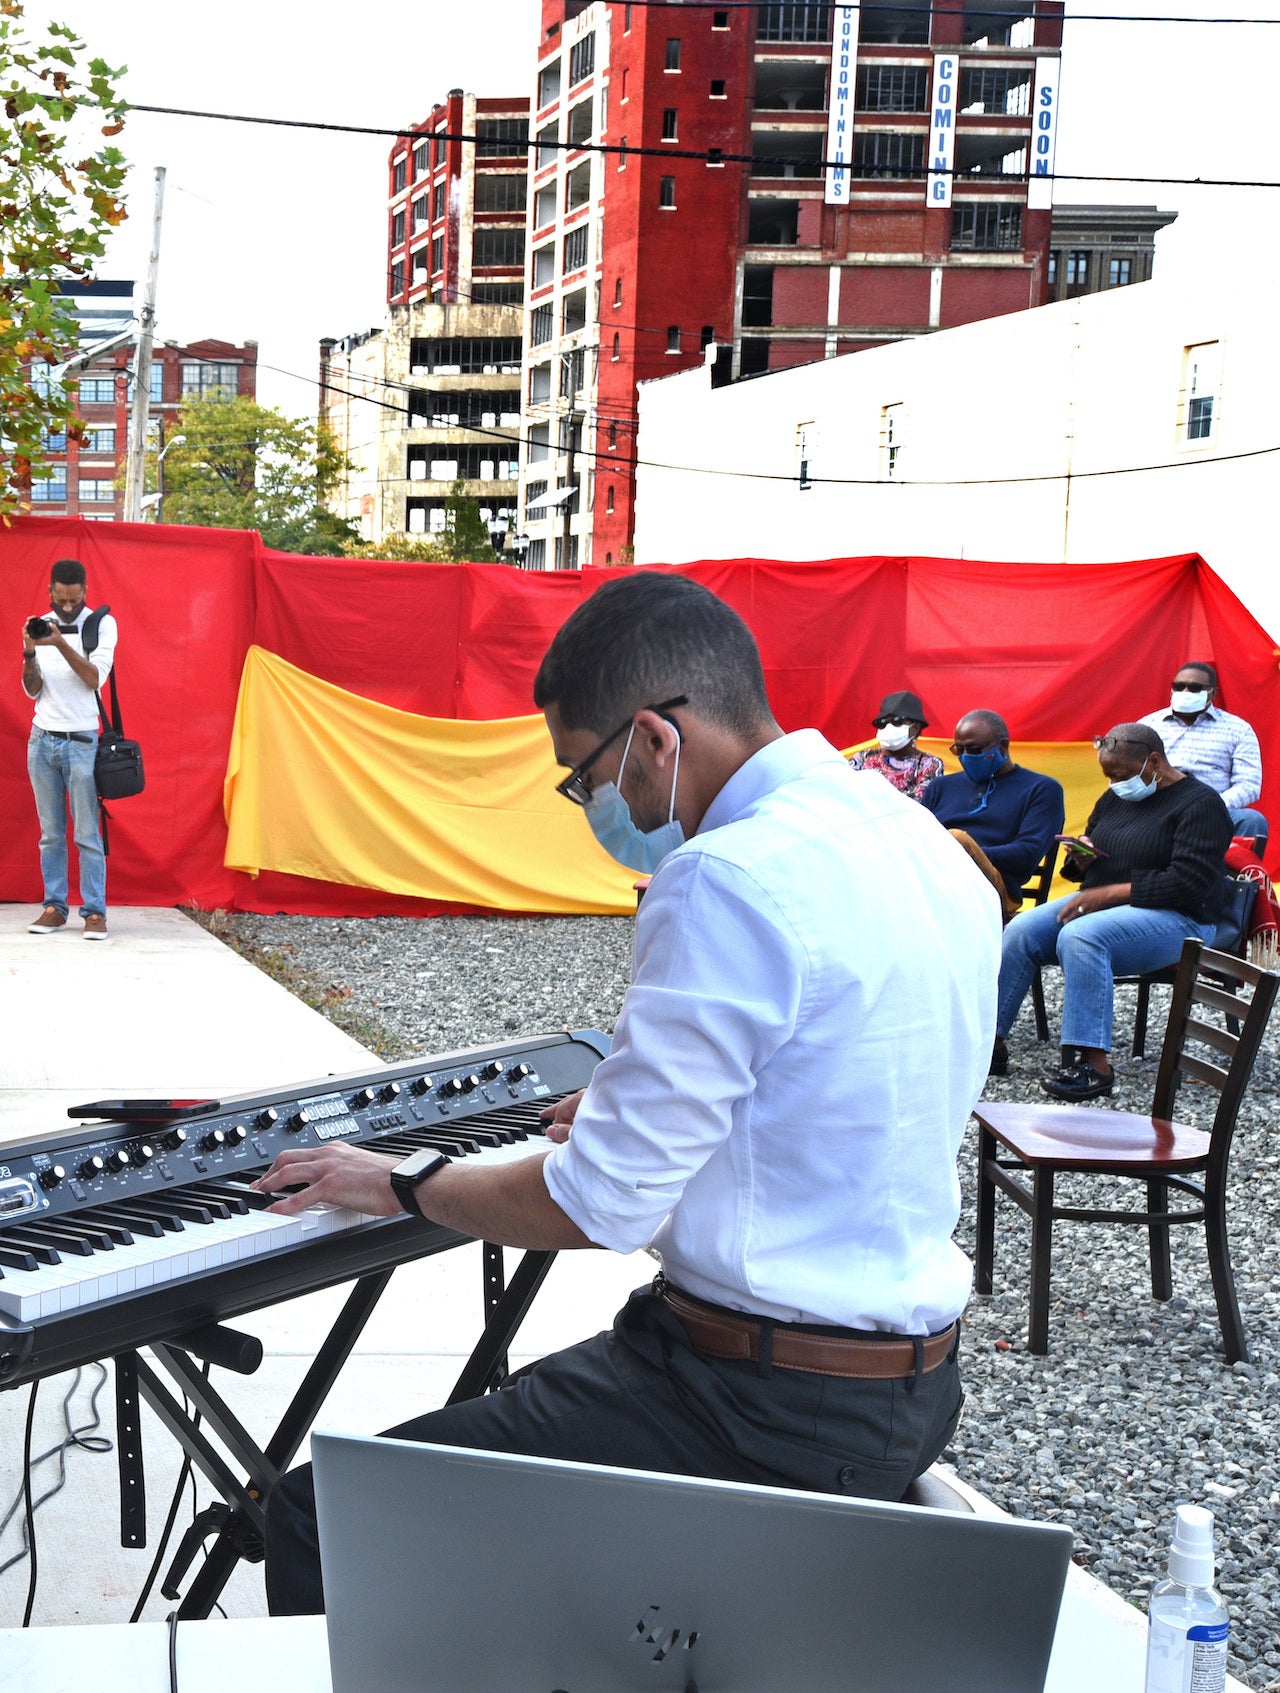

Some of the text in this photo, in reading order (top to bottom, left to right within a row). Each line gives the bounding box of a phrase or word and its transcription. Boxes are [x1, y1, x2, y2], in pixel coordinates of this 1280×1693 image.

[833, 7, 852, 197] CONDOMINIUMS
[933, 59, 953, 200] COMING
[1035, 86, 1053, 175] SOON
